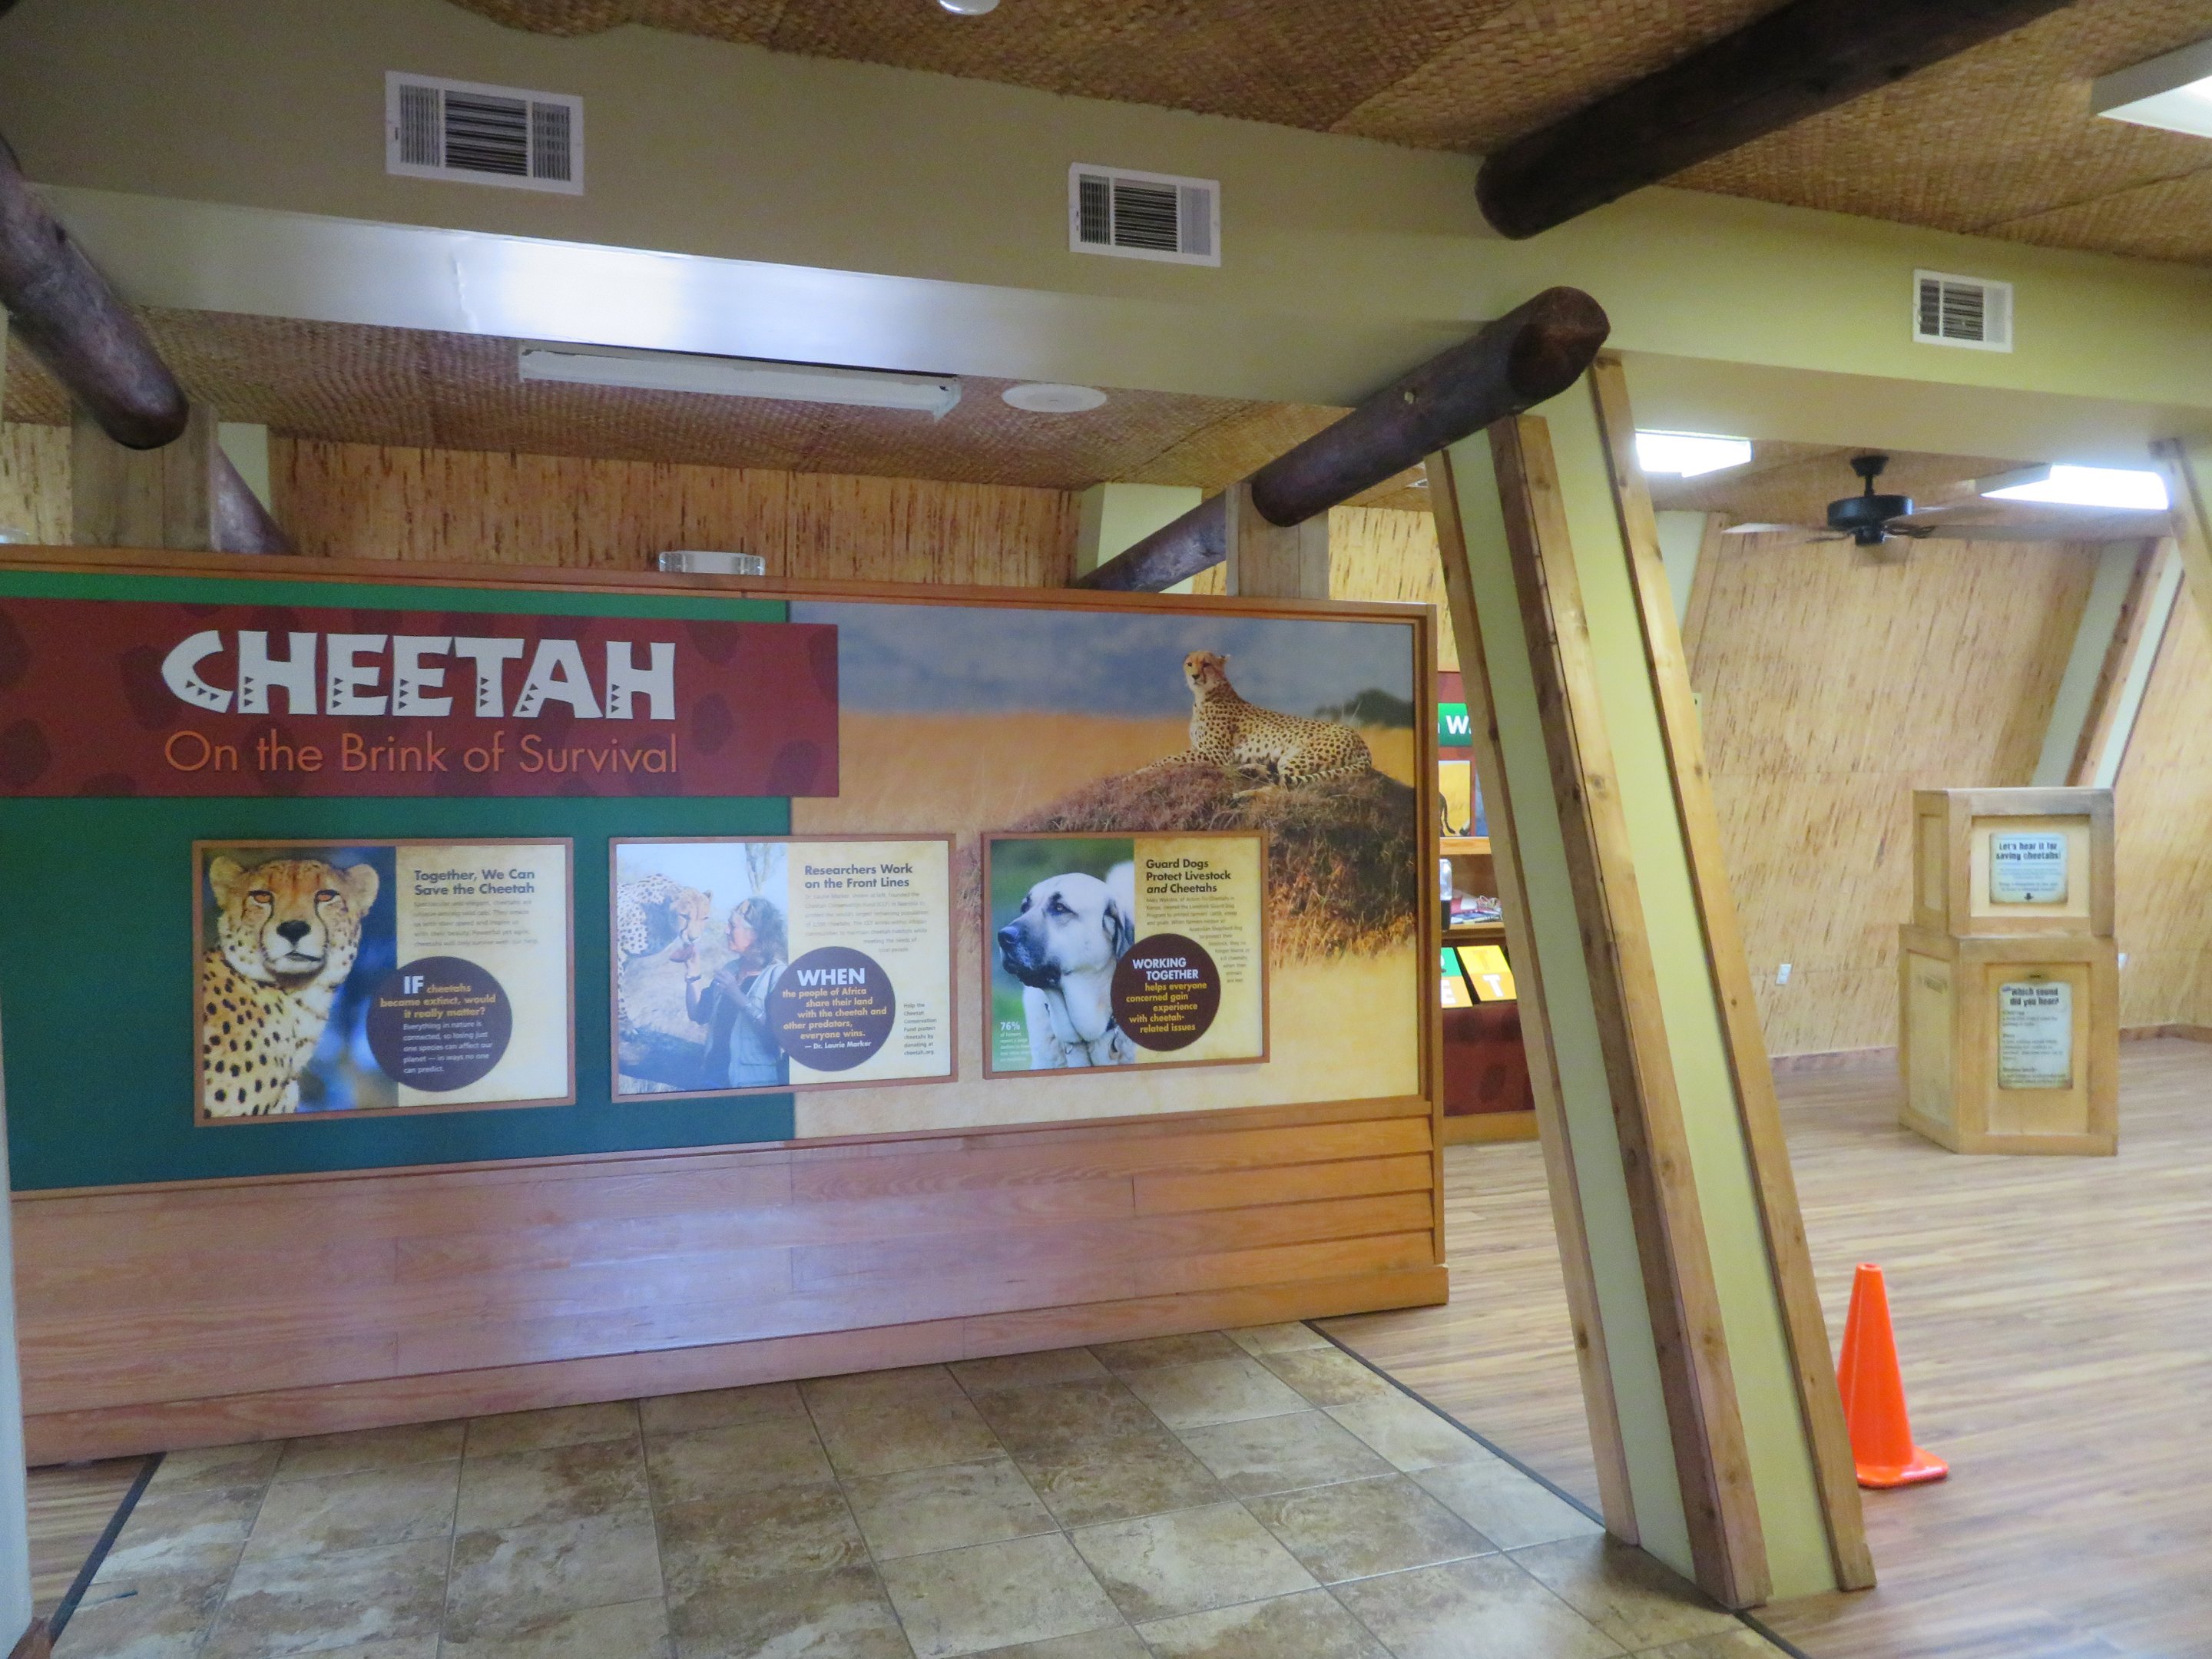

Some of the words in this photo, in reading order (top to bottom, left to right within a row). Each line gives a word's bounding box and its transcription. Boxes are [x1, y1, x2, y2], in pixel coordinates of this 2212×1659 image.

[161, 630, 676, 720] CHEETAH
[165, 730, 239, 772] On
[257, 728, 323, 772] the
[341, 731, 447, 773] Brink
[464, 730, 504, 772] of
[521, 733, 678, 773] Survival
[805, 864, 876, 875] Researchers
[880, 863, 912, 873] Work
[1146, 859, 1179, 869] Guard
[1183, 859, 1209, 870] Dogs
[414, 869, 477, 883] Together,
[482, 869, 504, 879] We
[509, 869, 535, 879] Can
[1146, 872, 1182, 881] Protect
[1185, 870, 1231, 880] Livestock
[415, 885, 449, 895] Save
[453, 883, 474, 894] the
[479, 882, 535, 893] Cheetah
[824, 879, 843, 888] the
[847, 879, 877, 888] Front
[881, 877, 909, 887] Lines
[1147, 884, 1167, 893] and
[1171, 882, 1217, 893] Cheetahs
[1132, 957, 1187, 969] WORKING
[797, 968, 866, 986] WHEN
[1146, 969, 1198, 981] TOGETHER
[404, 975, 424, 994] IF
[426, 983, 472, 993] cheetahs
[1145, 982, 1167, 992] helps
[1169, 982, 1207, 992] everyone
[1482, 974, 1503, 997] T
[783, 989, 796, 998] the
[799, 988, 828, 998] people
[830, 987, 839, 995] of
[841, 986, 866, 995] Africa
[1126, 992, 1167, 1002] concerned
[1171, 992, 1188, 1002] gain
[380, 998, 420, 1007] become
[464, 994, 496, 1004] would
[806, 999, 830, 1008] share
[832, 998, 852, 1006] their
[854, 997, 873, 1005] land
[404, 1009, 411, 1018] it
[414, 1008, 443, 1018] really
[447, 1007, 485, 1016] matter?
[797, 1009, 816, 1018] with
[820, 1008, 833, 1017] the
[835, 1008, 868, 1017] cheetah
[870, 1006, 887, 1015] and
[1153, 1002, 1197, 1013] experience
[1129, 1014, 1147, 1023] with
[1150, 1013, 1184, 1022] cheetah-
[783, 1021, 806, 1030] other
[809, 1020, 853, 1031] predators,
[1000, 1022, 1020, 1031] 76%
[1140, 1023, 1169, 1033] related
[1171, 1023, 1196, 1031] issues
[800, 1031, 840, 1041] everyone
[843, 1029, 866, 1038] wins.
